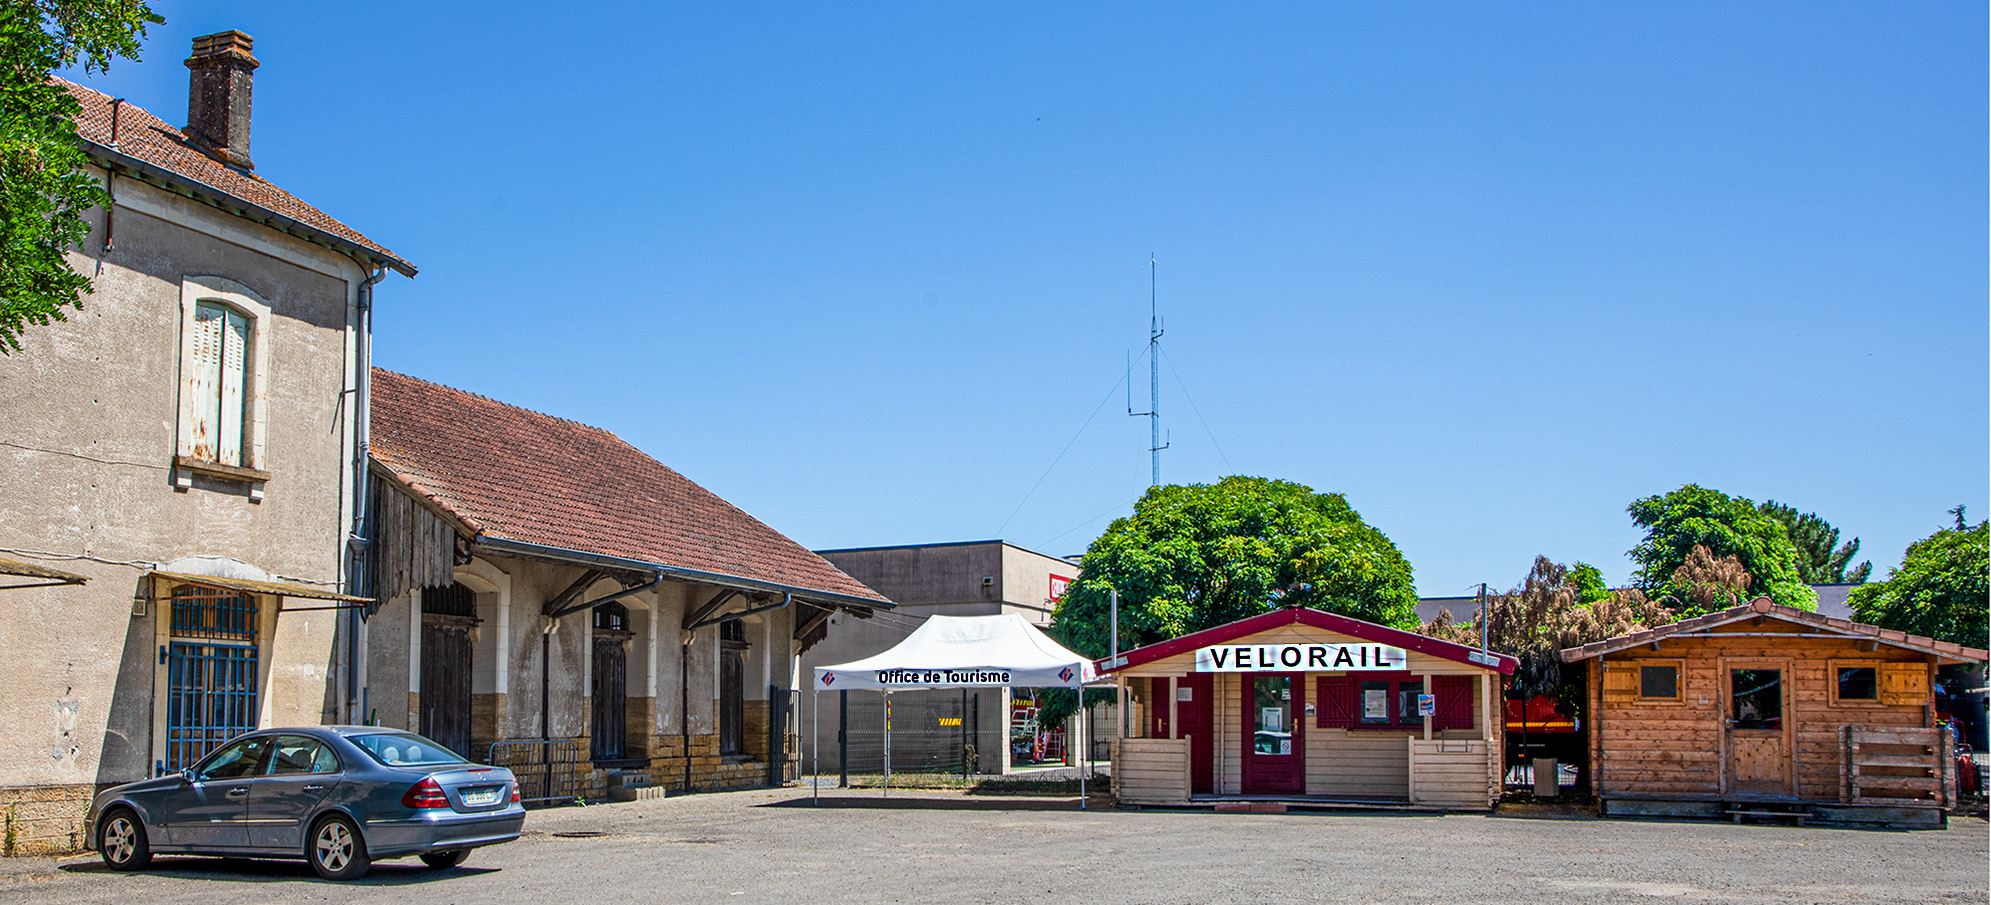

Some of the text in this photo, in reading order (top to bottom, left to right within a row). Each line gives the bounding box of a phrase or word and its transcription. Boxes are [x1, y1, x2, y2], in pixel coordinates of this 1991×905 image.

[1209, 646, 1391, 669] VELORAIL
[878, 668, 1010, 684] Office de Tourisme
